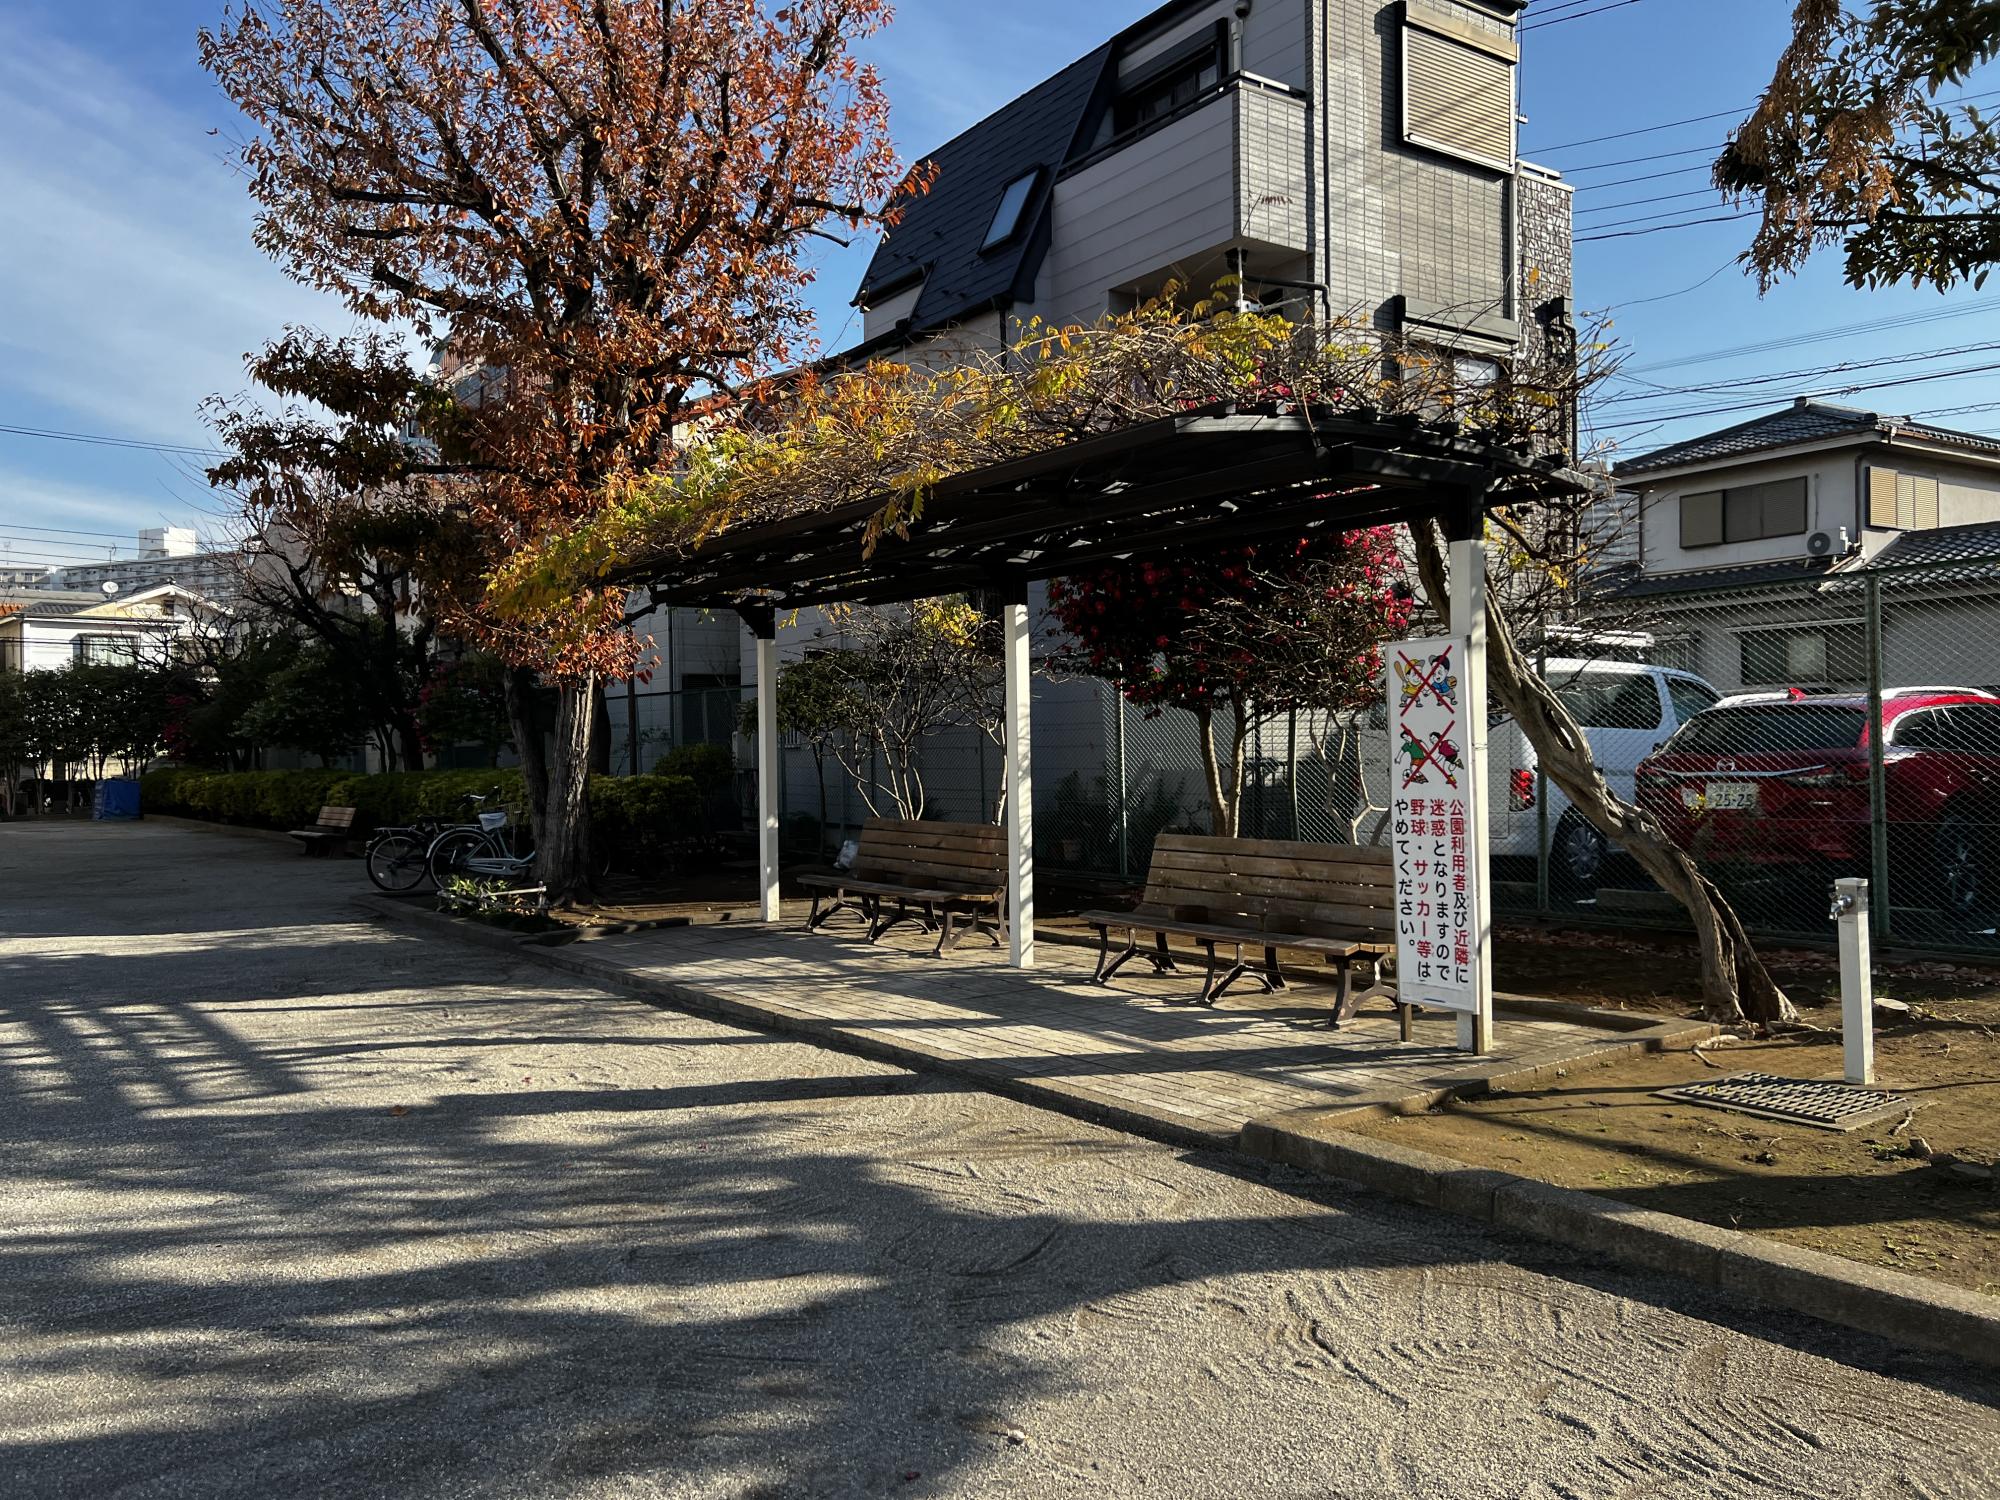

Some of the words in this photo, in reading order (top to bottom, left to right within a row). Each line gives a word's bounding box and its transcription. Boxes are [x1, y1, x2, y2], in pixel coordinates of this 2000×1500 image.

[1394, 799, 1415, 946] やめてください。
[1410, 799, 1431, 977] 野球・サッカー等は
[1430, 799, 1450, 981] 迷惑となりますので
[1449, 799, 1469, 983] 公園利用者及び近隣に
